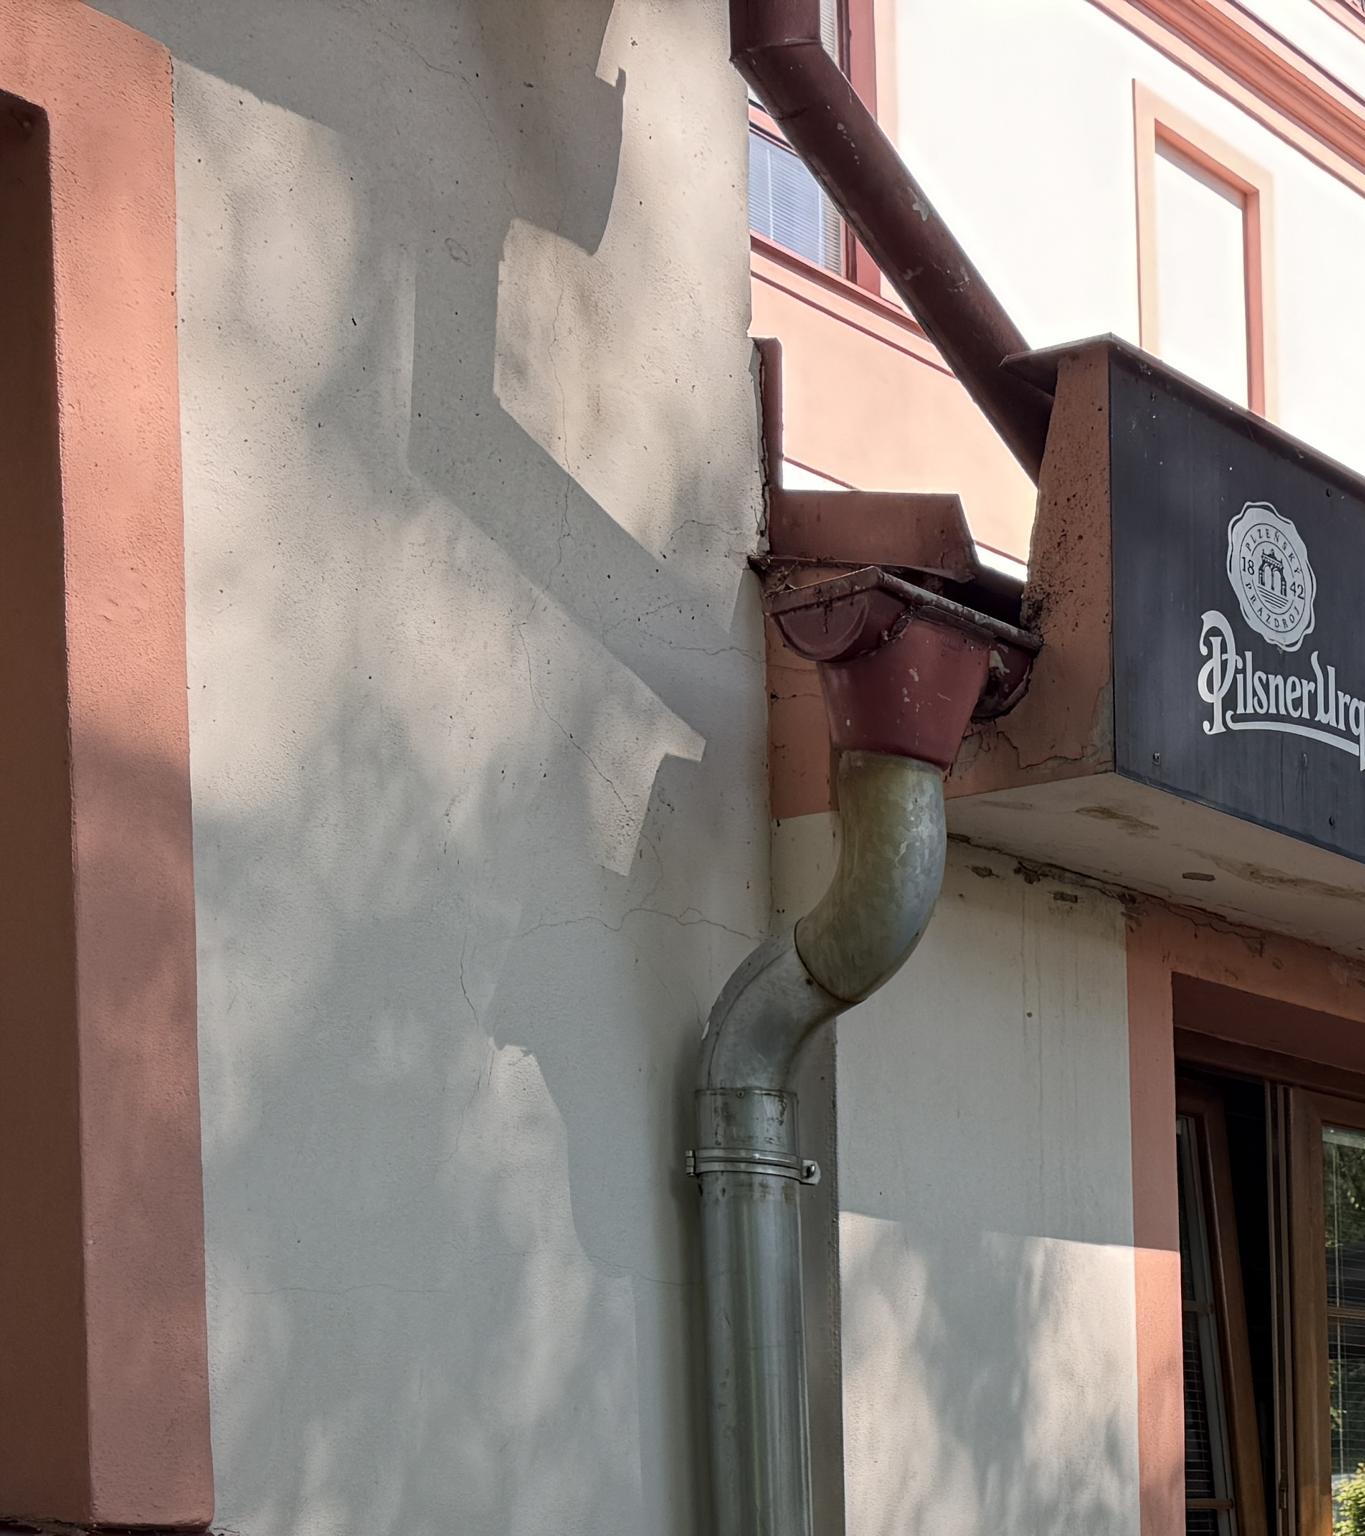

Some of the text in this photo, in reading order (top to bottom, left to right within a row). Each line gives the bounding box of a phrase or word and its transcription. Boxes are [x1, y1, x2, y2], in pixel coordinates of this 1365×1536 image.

[1241, 556, 1255, 575] 18
[1290, 581, 1305, 600] 42
[1198, 610, 1316, 736] Pilsner
